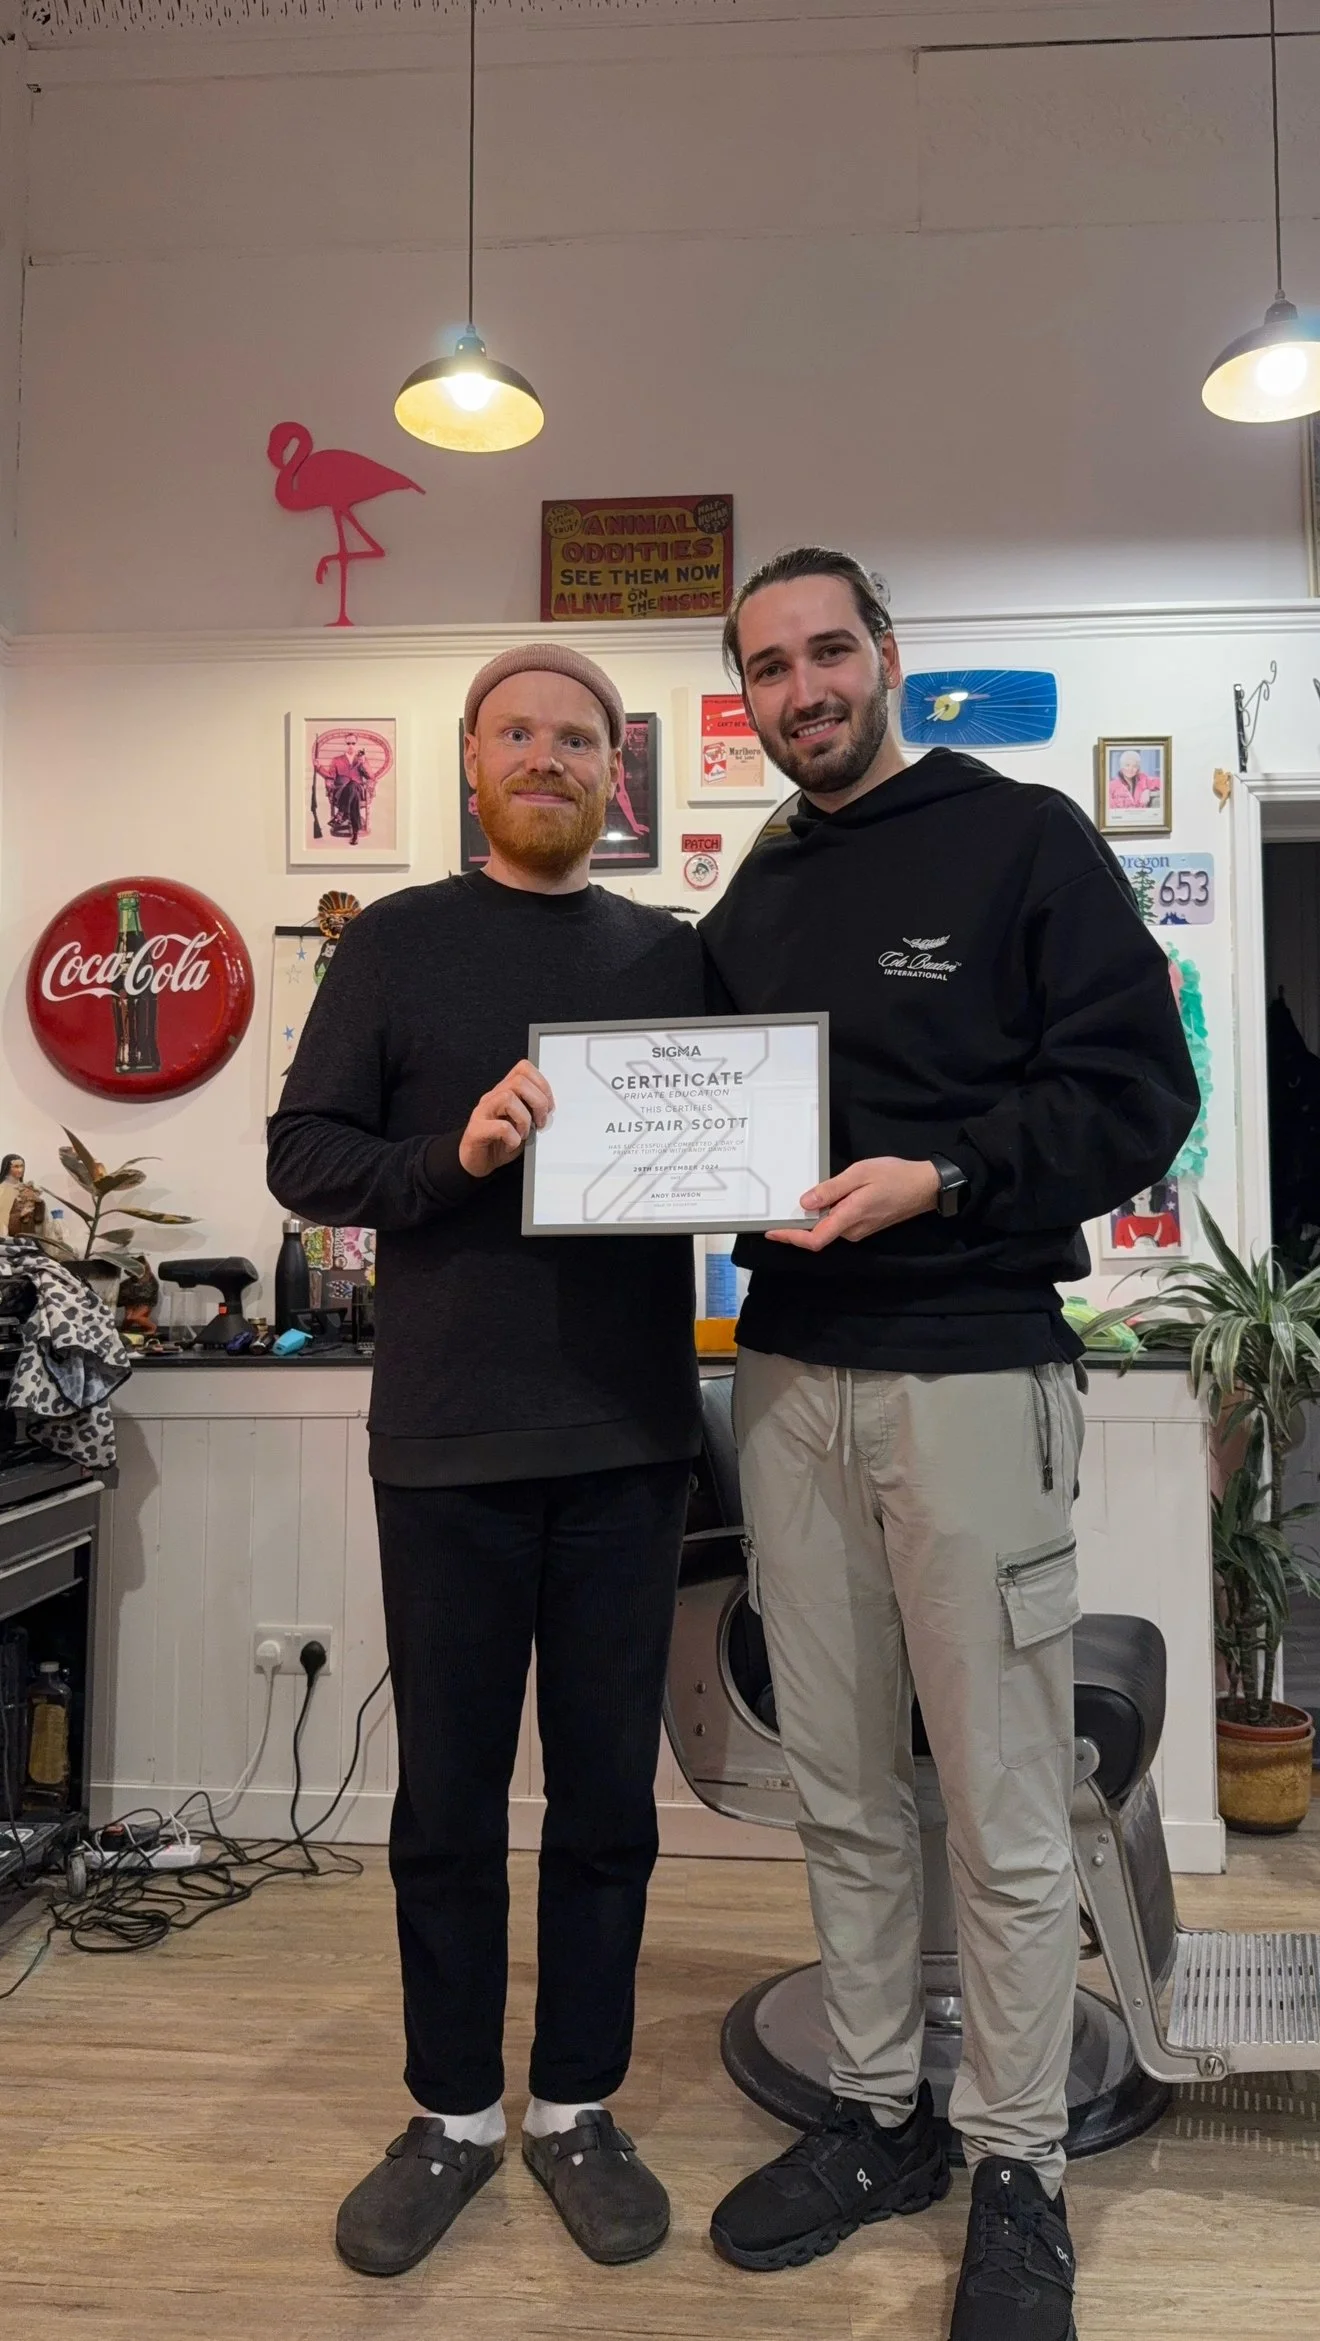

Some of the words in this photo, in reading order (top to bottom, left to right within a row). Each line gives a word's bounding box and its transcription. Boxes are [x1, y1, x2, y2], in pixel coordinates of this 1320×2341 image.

[583, 513, 697, 536] ANIMAL
[562, 538, 714, 564] ODDITIES
[560, 569, 602, 586] SEE
[609, 567, 669, 585] THEM
[677, 563, 720, 582] NOW
[628, 588, 647, 600] ON
[657, 591, 722, 612] INSIDE
[553, 592, 624, 614] ALIVE
[628, 598, 657, 614] THE
[729, 747, 761, 755] Marlboro
[684, 839, 719, 849] PATCH
[1159, 871, 1209, 906] 653
[884, 969, 948, 981] INTERNATIONAL
[652, 1045, 701, 1058] SIGMA
[611, 1071, 743, 1090] CERTIFICATE
[624, 1091, 665, 1100] PRIVATE
[669, 1088, 730, 1099] EDUCATION
[665, 1104, 713, 1113] CERTIFIES
[605, 1120, 683, 1133] ALISTAIR
[691, 1117, 748, 1130] SCOTT
